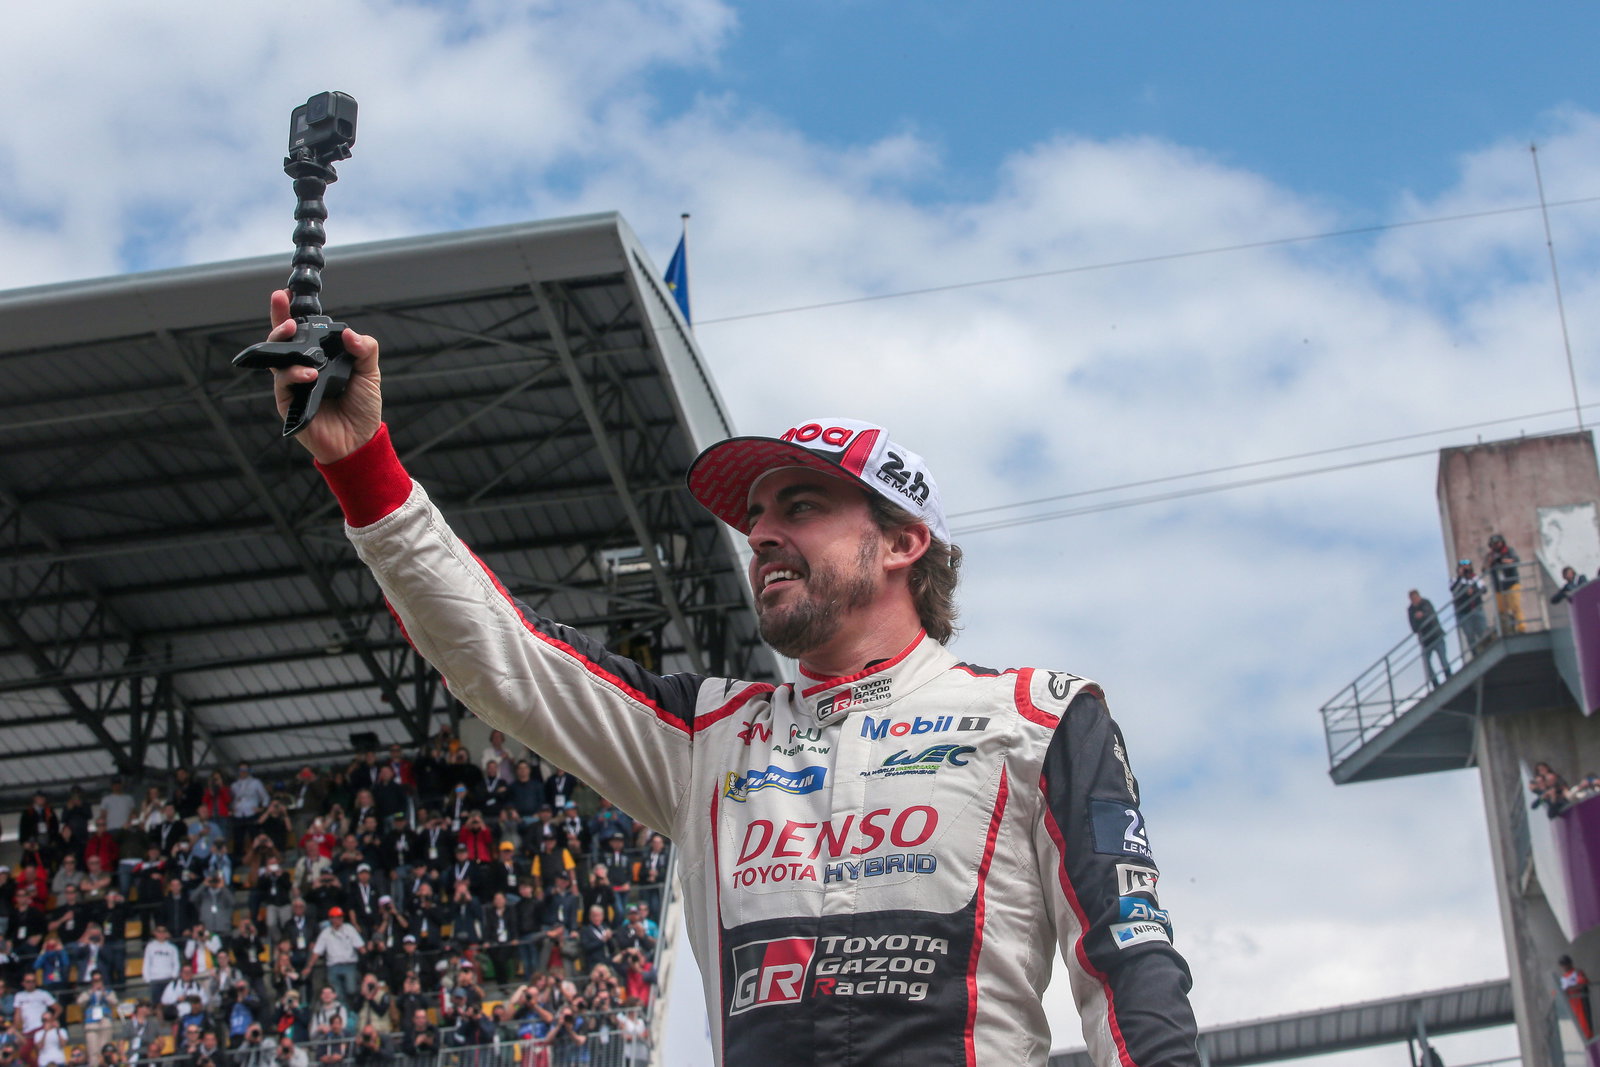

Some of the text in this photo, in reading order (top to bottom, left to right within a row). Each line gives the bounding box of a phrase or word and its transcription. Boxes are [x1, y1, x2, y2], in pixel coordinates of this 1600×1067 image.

[876, 469, 925, 507] LE MANS
[852, 678, 893, 692] TOYOTA
[854, 686, 890, 700] GAZOO
[818, 698, 852, 716] GR
[853, 692, 892, 706] Racing
[860, 715, 954, 741] Mobil
[807, 745, 831, 755] AW
[881, 744, 978, 767] WEC
[871, 767, 896, 776] WORLD
[736, 805, 939, 867] DENSO
[1122, 841, 1139, 853] LE
[732, 853, 937, 889] TOYOTA HYBRID
[821, 934, 949, 955] TOYOTA
[815, 956, 936, 976] GAZOO
[735, 963, 804, 1009] GR
[810, 975, 929, 1001] Racing
